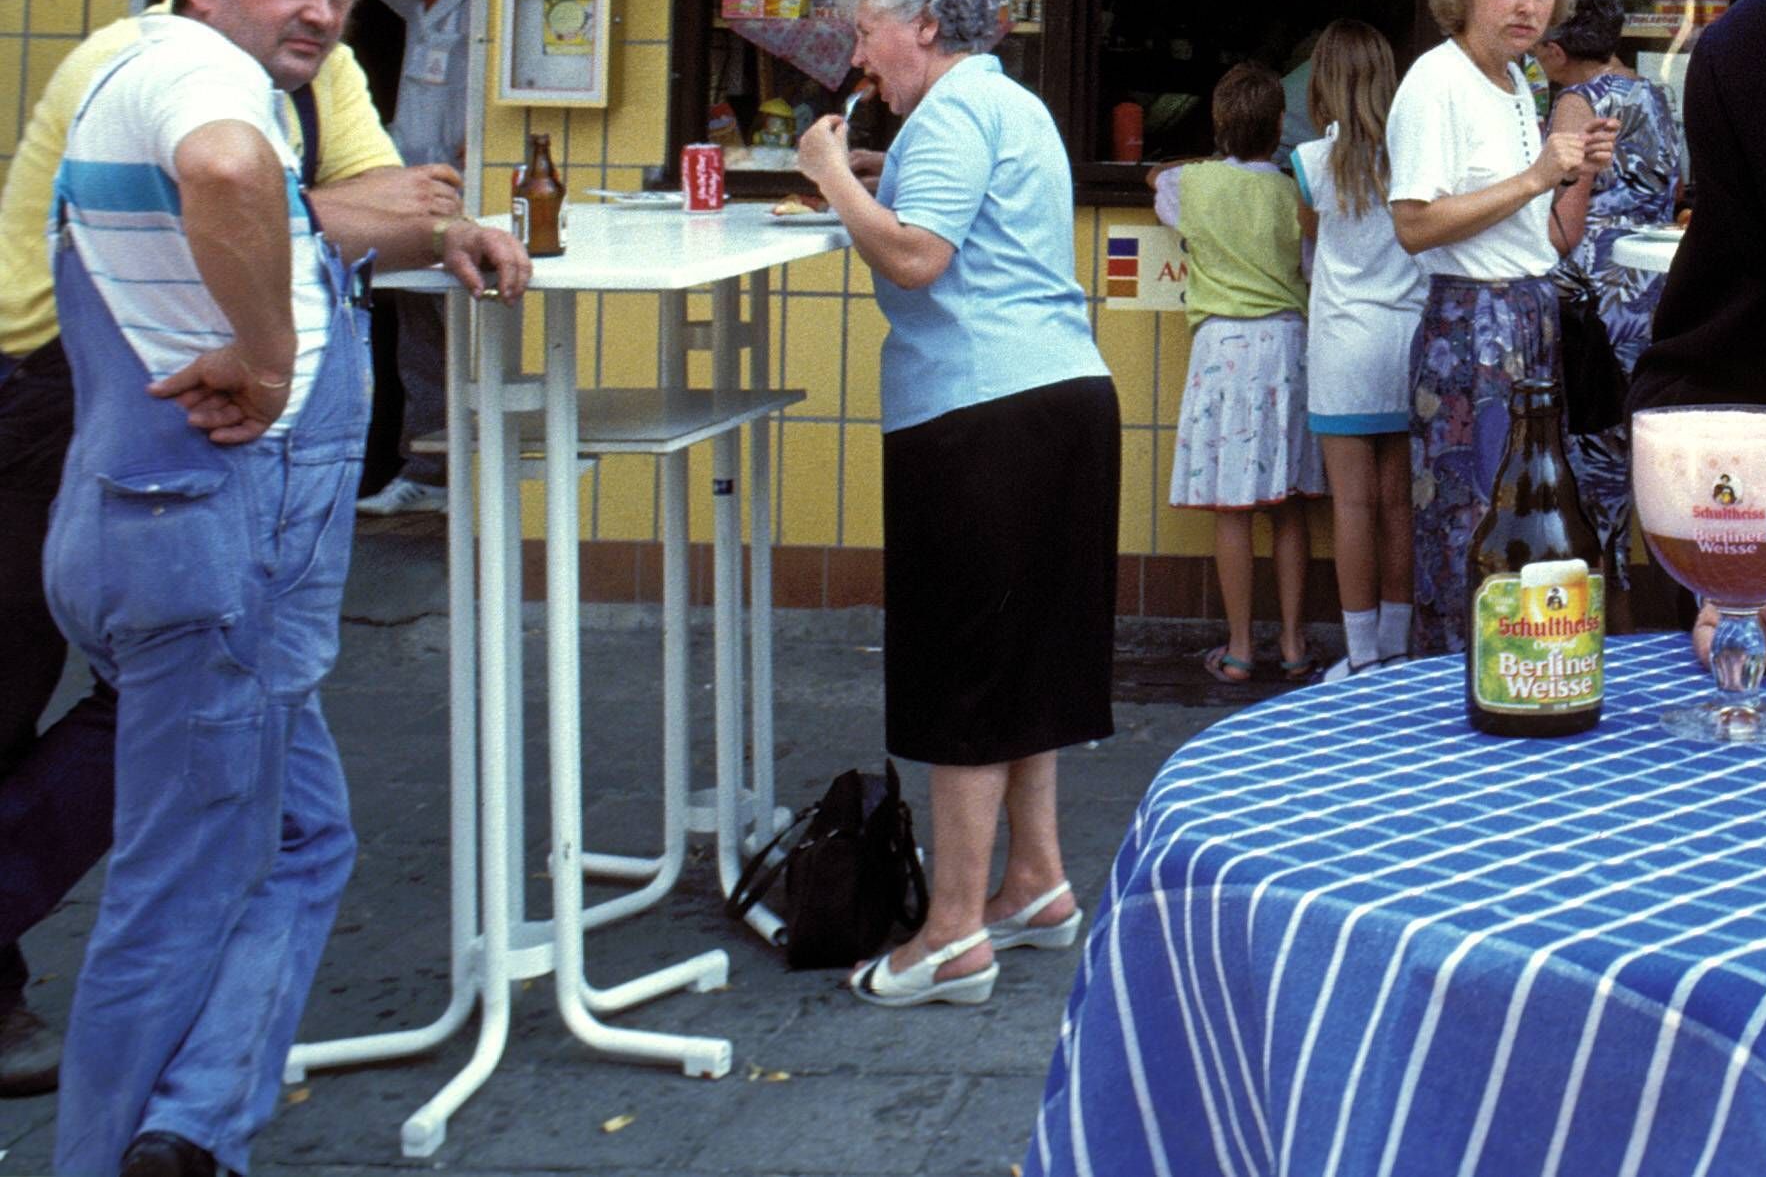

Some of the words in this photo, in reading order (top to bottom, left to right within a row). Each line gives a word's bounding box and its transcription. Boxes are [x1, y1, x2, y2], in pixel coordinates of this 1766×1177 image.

[1692, 505, 1766, 520] Schultheiss
[1699, 542, 1758, 555] Weisse
[1498, 612, 1600, 637] Schultheiss
[1499, 650, 1600, 677] Berliner
[1505, 675, 1593, 699] Weisse
